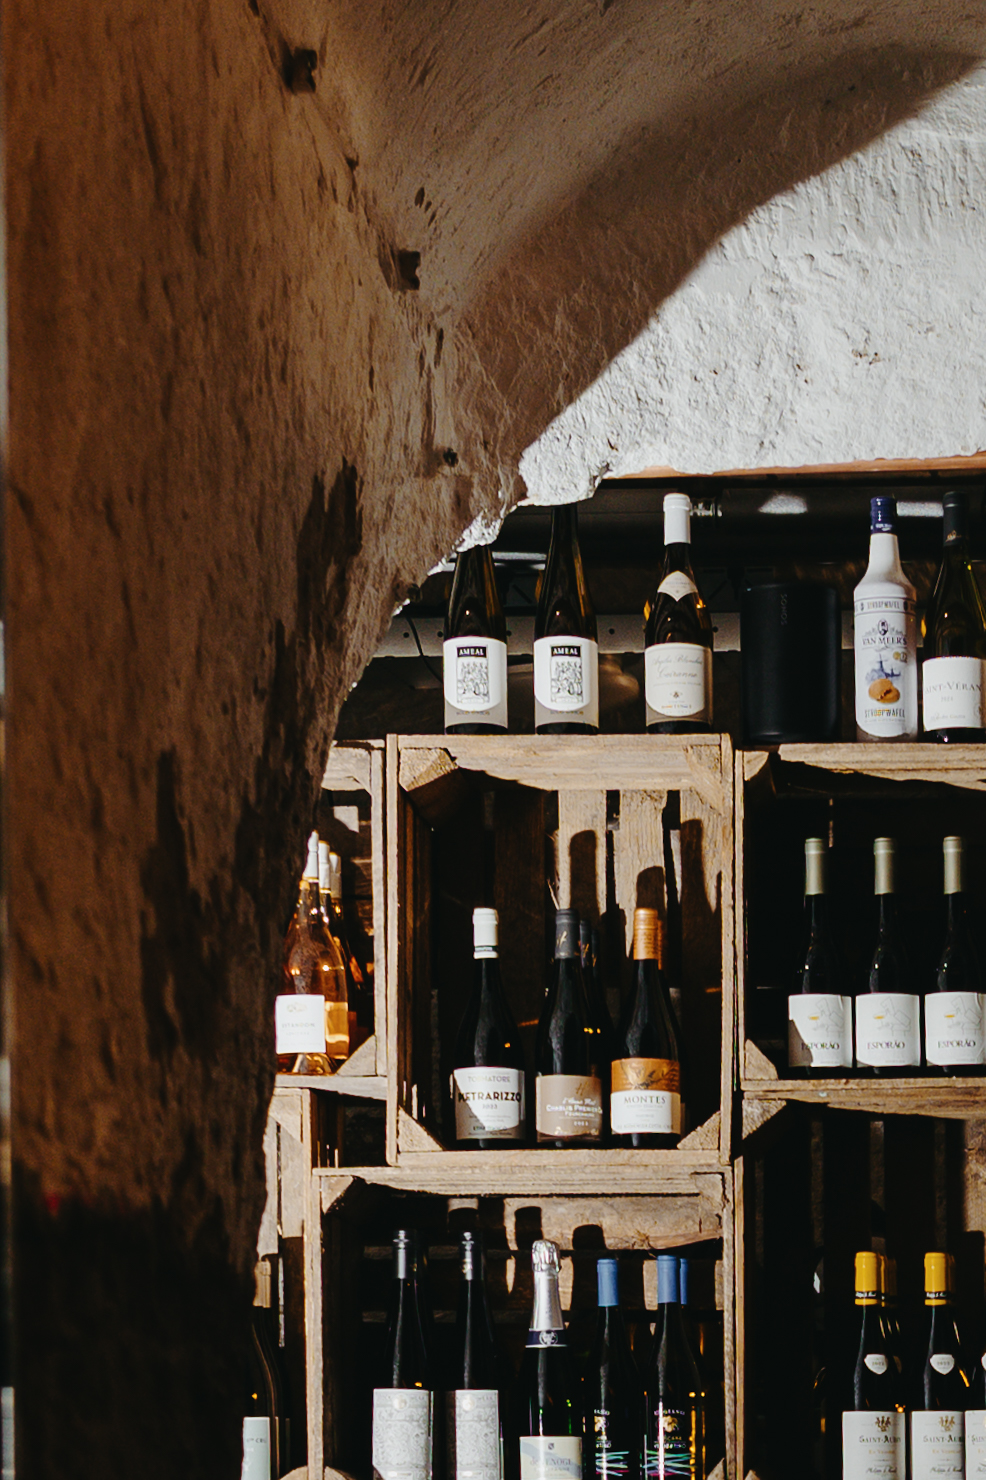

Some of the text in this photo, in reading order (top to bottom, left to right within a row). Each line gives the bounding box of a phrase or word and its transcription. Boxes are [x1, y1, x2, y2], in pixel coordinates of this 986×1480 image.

[780, 593, 788, 626] SONOS
[458, 647, 484, 656] AMEAL
[552, 647, 578, 655] AMEAL
[864, 708, 904, 718] STROOPWAFEL
[801, 1040, 840, 1050] ESPORÃO
[867, 1039, 905, 1050] ESPORÃO
[937, 1038, 976, 1049] ESPORÃO
[458, 1091, 522, 1103] PIETRARIZZO
[624, 1095, 667, 1105] MONTES
